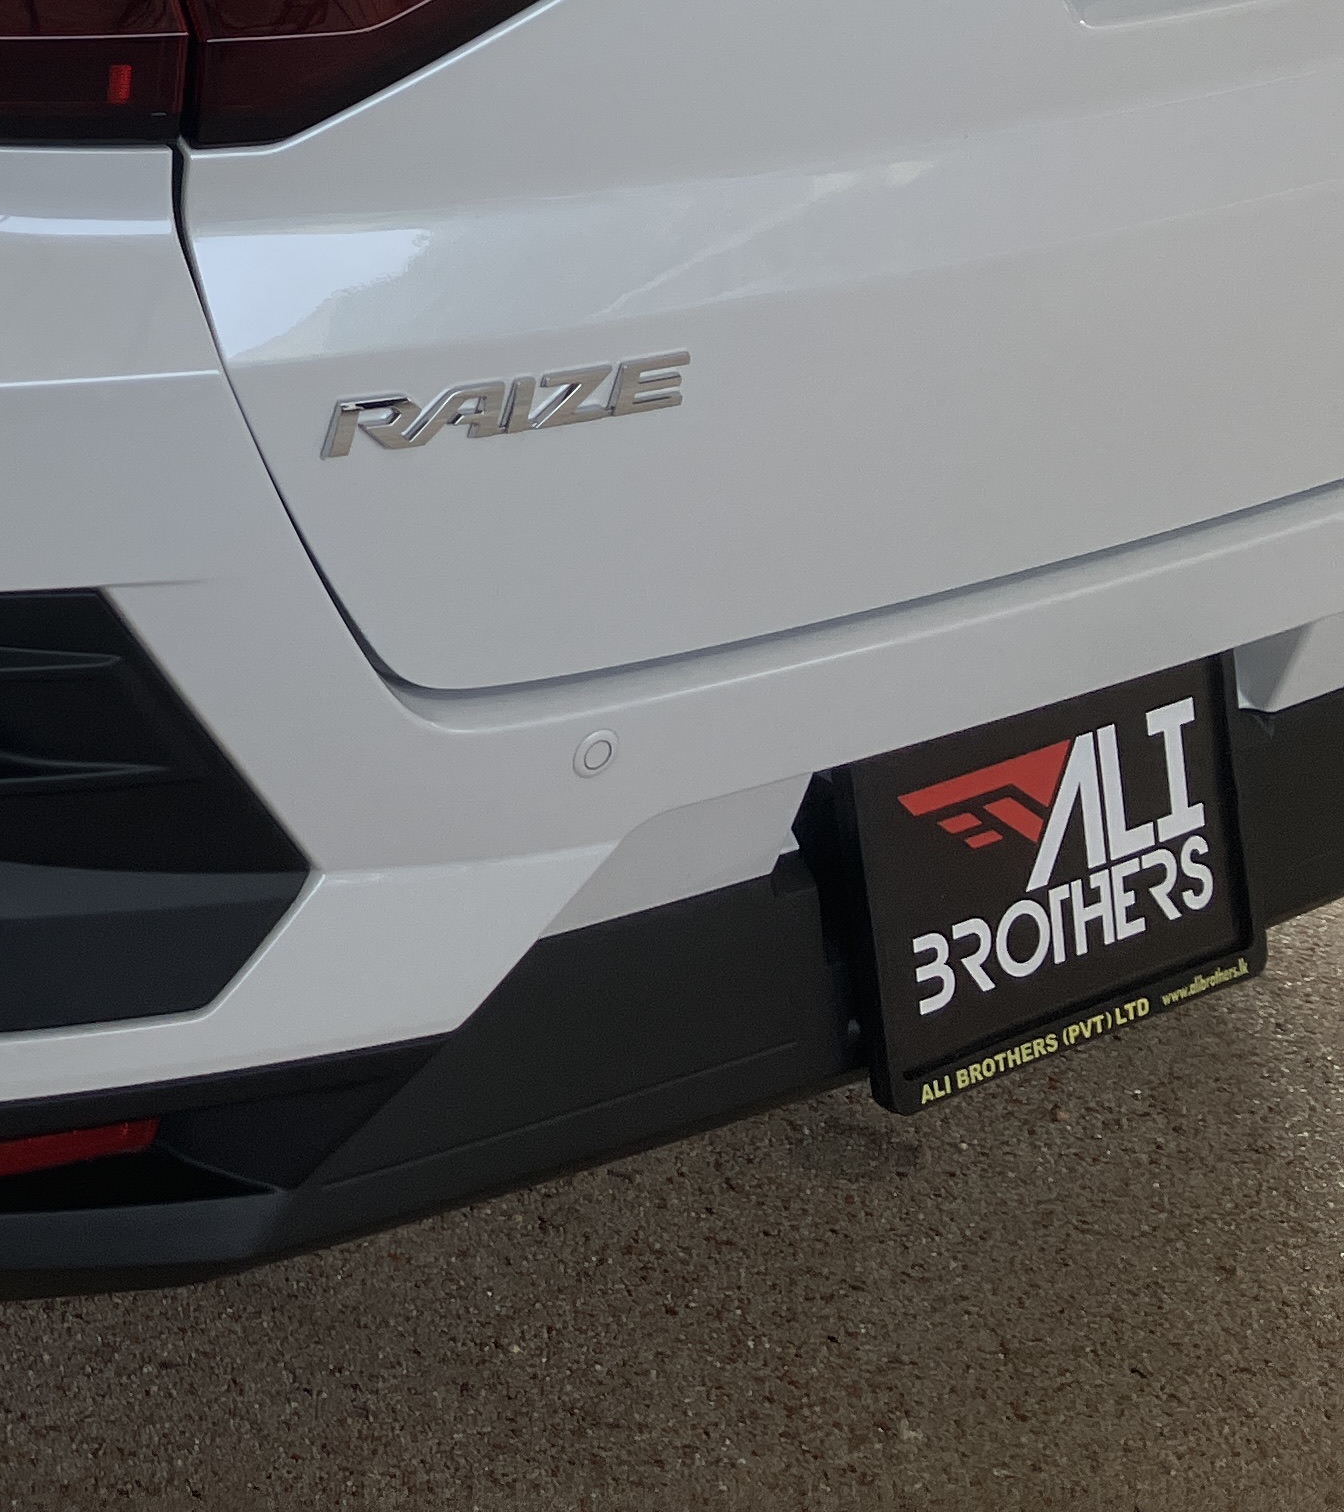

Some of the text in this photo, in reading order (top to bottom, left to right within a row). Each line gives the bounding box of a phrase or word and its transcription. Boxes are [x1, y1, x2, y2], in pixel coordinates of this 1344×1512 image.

[320, 350, 692, 461] RAIZE
[1025, 696, 1206, 893] ALI
[912, 835, 1214, 1016] BROTHERS
[920, 1074, 952, 1104] ALI
[956, 1033, 1059, 1089] BROTHERS
[1062, 1011, 1113, 1046] (PVT)
[1115, 997, 1150, 1026] LTD
